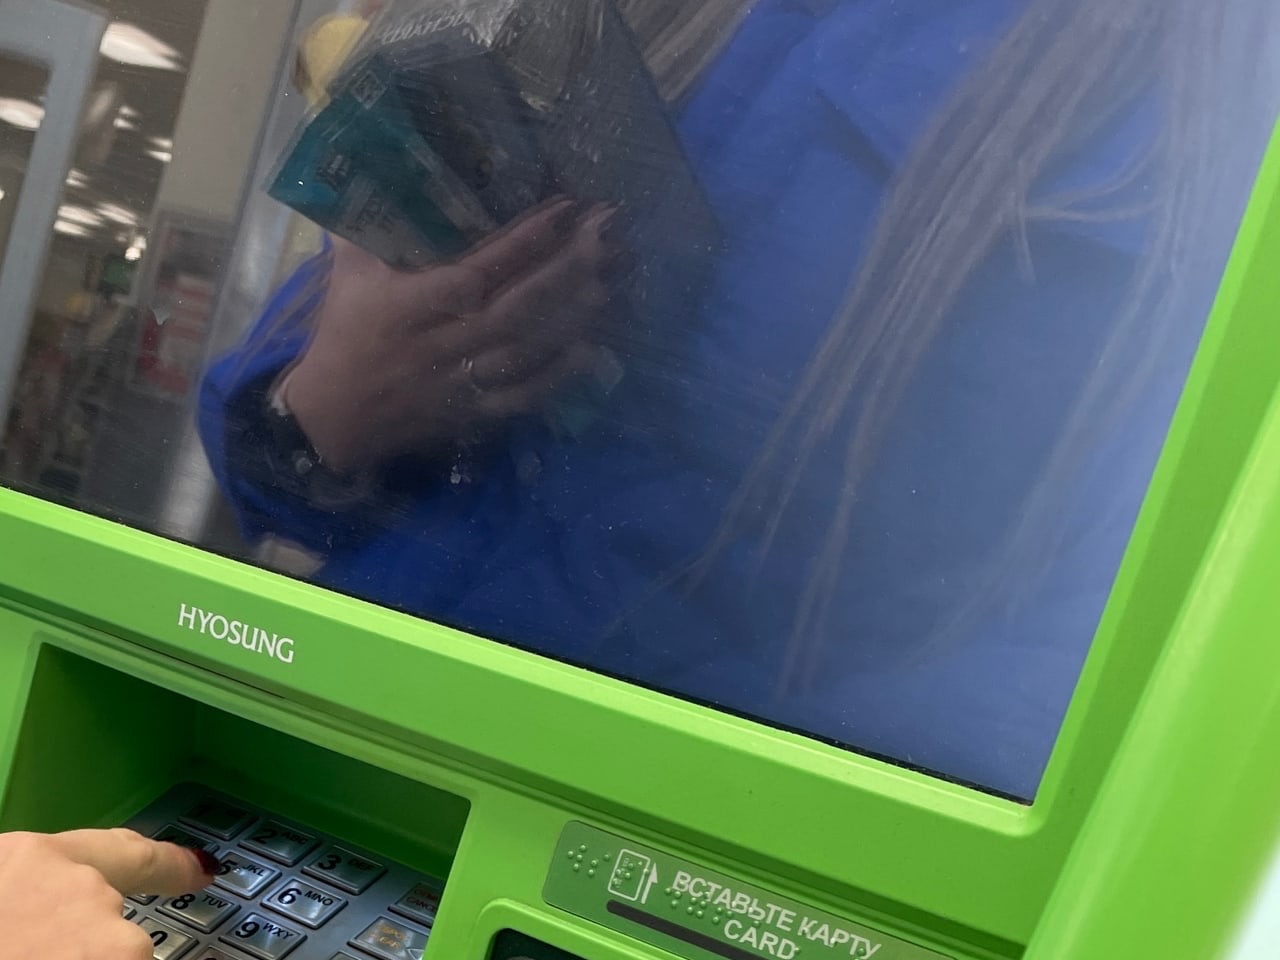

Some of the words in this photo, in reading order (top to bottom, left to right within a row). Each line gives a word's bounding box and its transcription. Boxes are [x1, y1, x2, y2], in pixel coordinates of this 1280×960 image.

[178, 602, 295, 664] HYOSUNG
[253, 827, 275, 846] 2
[282, 831, 308, 846] ABC
[219, 859, 237, 876] 5
[242, 864, 265, 877] JKL
[318, 854, 342, 872] 3
[349, 858, 372, 873] DEF
[170, 892, 196, 910] 8
[203, 894, 230, 909] TUV
[277, 887, 303, 906] 6
[304, 890, 334, 907] MNO
[672, 870, 797, 933] ВСТАВЬТЕ
[797, 916, 883, 960] КАРТУ
[235, 920, 261, 939] 9
[263, 922, 296, 940] WXY
[723, 918, 797, 960] CARD
